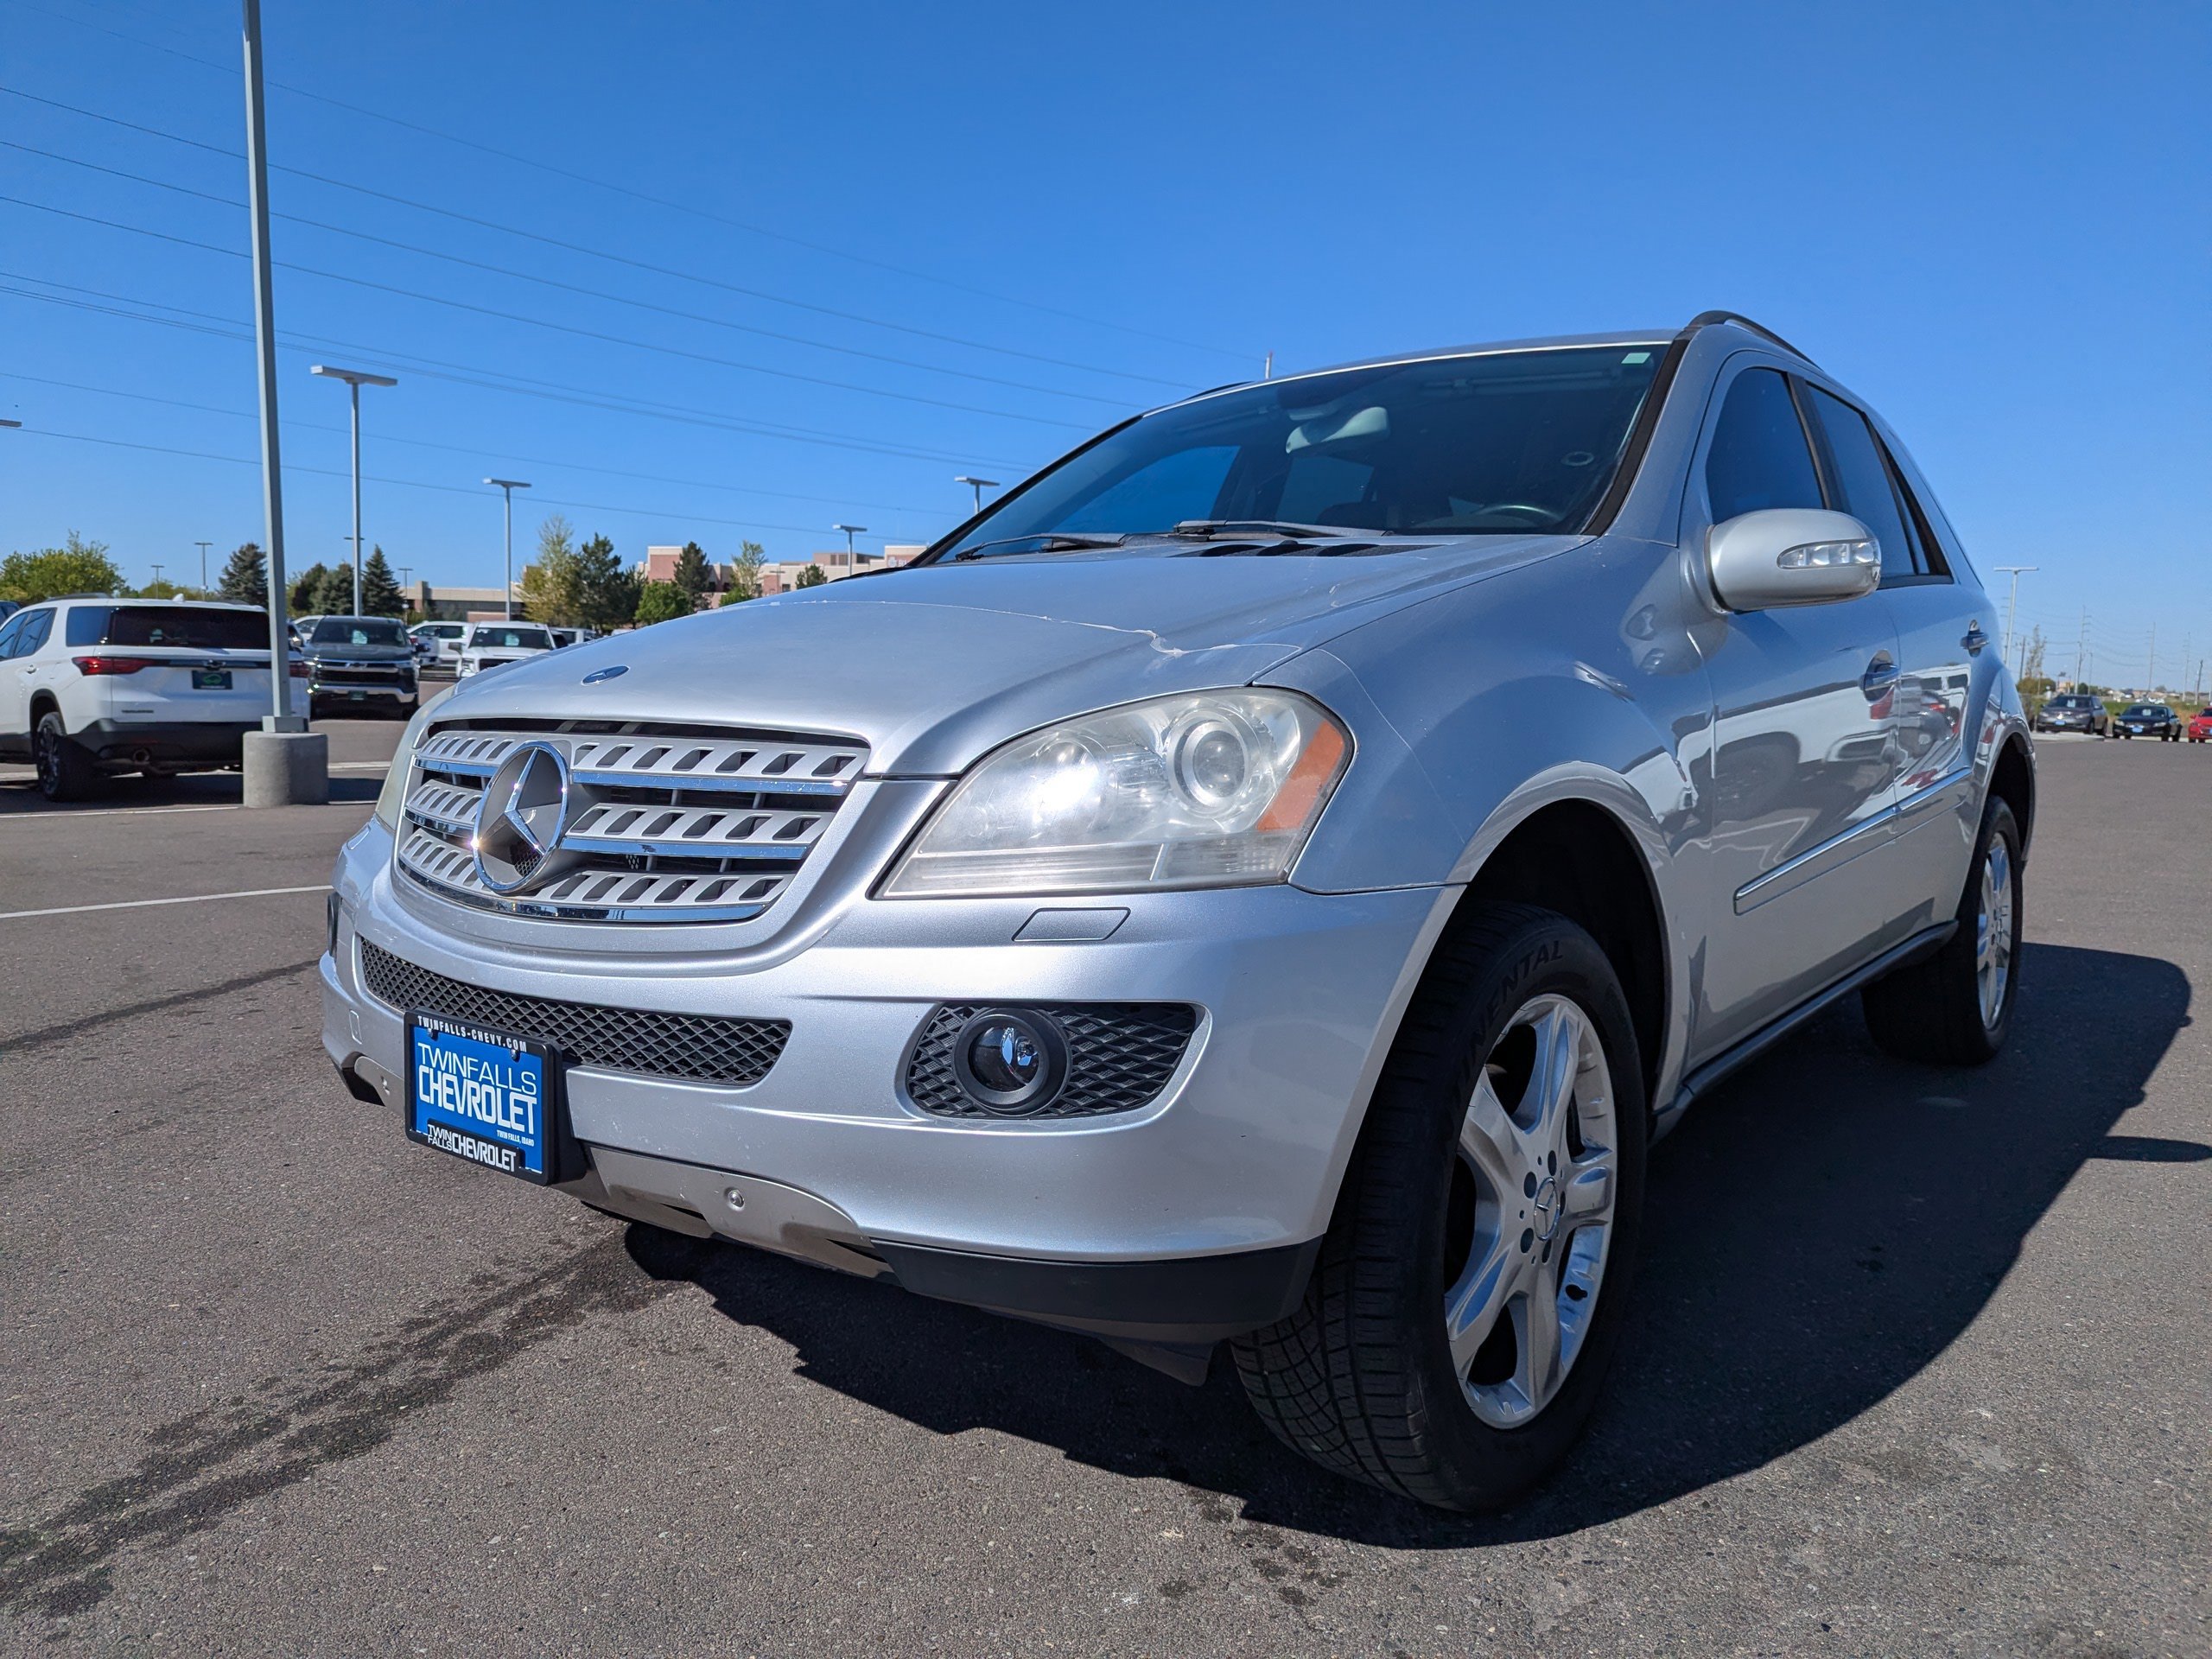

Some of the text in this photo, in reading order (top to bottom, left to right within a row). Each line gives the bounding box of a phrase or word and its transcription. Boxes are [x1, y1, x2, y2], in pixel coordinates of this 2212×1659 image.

[417, 1015, 527, 1052] TWINFALLS-CHEVY.COM
[418, 1065, 537, 1135] CHEVROLET
[427, 1123, 452, 1141] TWIN
[428, 1135, 453, 1151] FALLS
[452, 1133, 517, 1172] CHEVROLET
